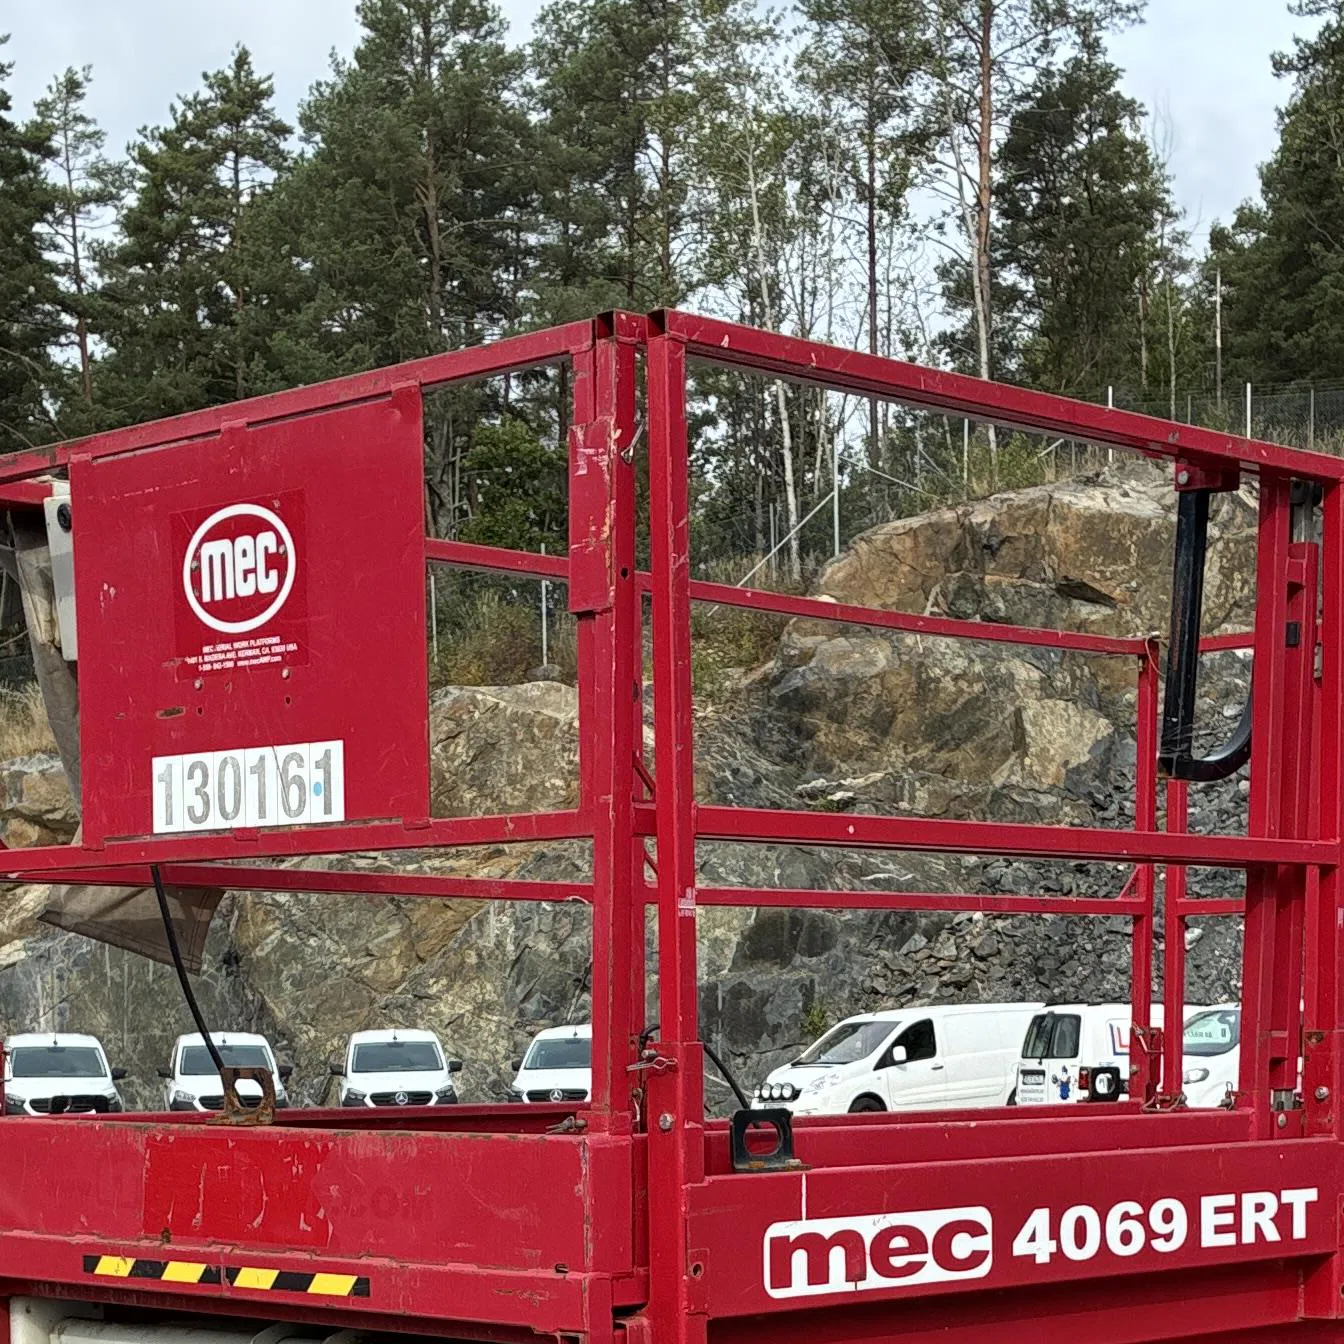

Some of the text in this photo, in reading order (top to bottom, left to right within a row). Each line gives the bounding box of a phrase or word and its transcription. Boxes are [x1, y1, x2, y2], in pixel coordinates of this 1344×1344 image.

[156, 748, 333, 826] 130161
[769, 1187, 1318, 1290] mec 4069 ERT
